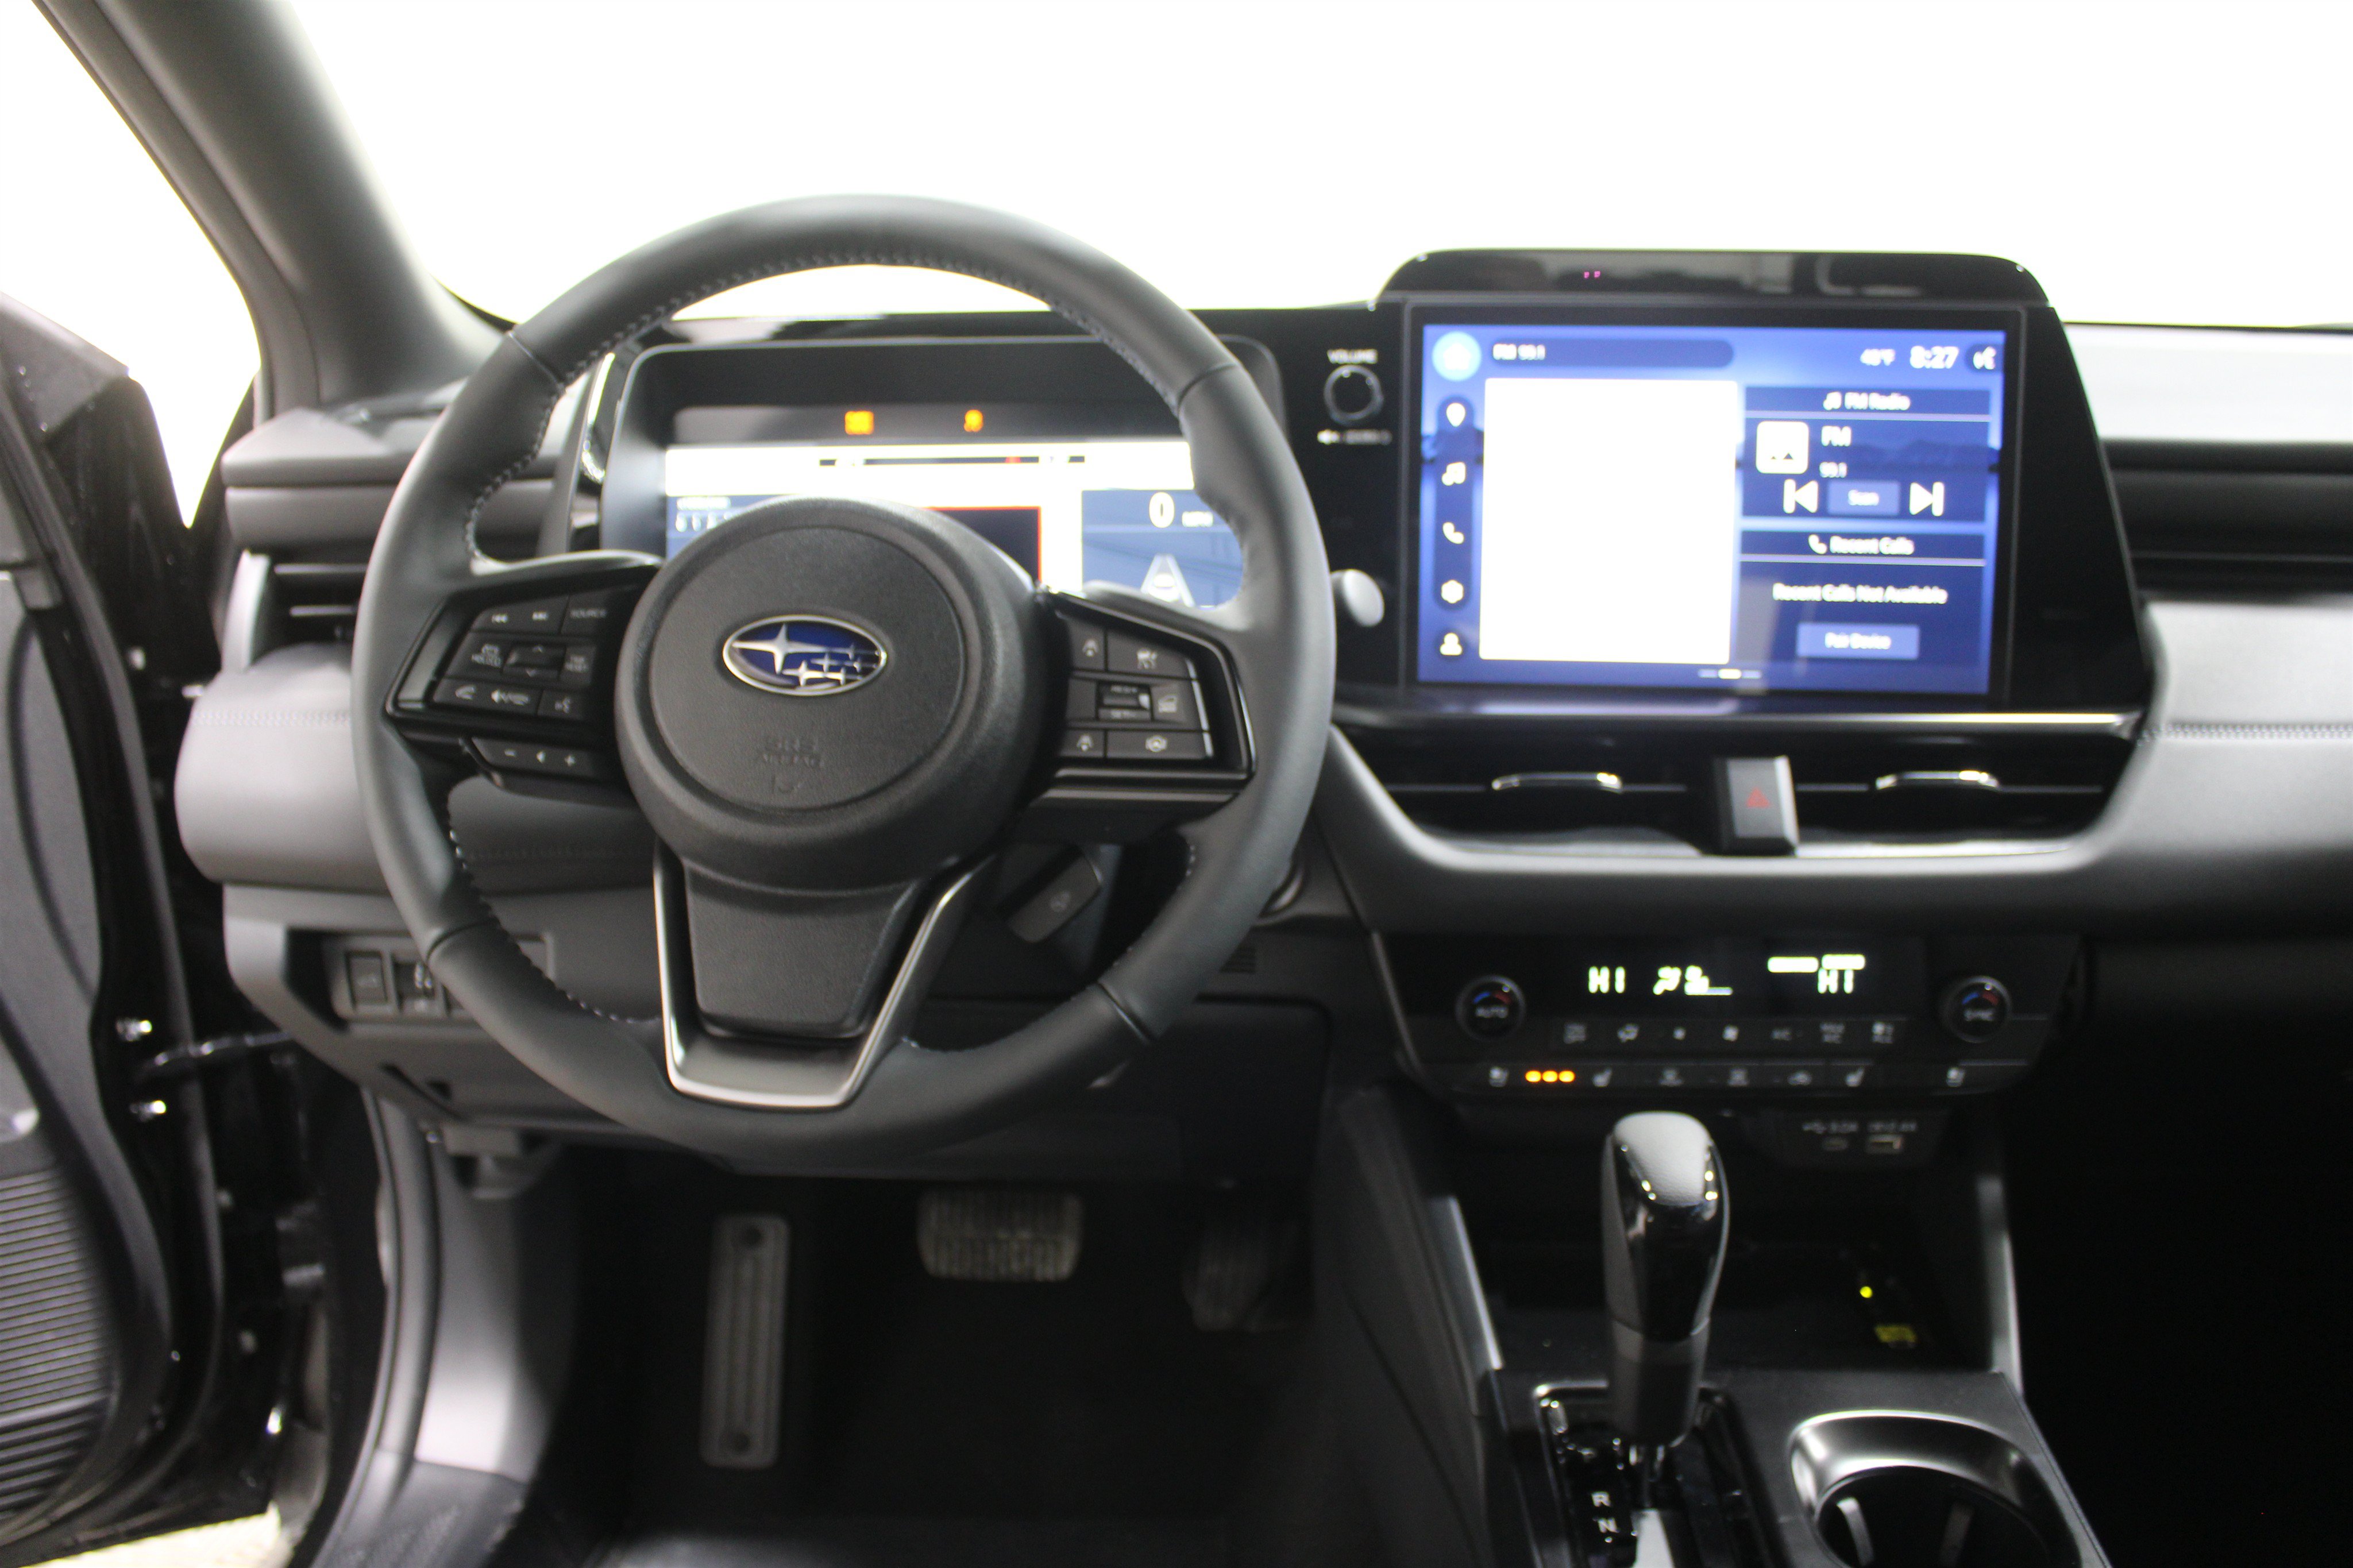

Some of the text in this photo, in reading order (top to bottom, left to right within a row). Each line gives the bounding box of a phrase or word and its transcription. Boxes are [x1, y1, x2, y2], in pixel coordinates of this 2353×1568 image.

[1326, 348, 1378, 365] VOLUME
[1910, 345, 1959, 369] 8:27
[1149, 492, 1175, 529] 0
[1588, 966, 1626, 994] HI
[1591, 1491, 1611, 1507] R
[1596, 1517, 1618, 1534] N
